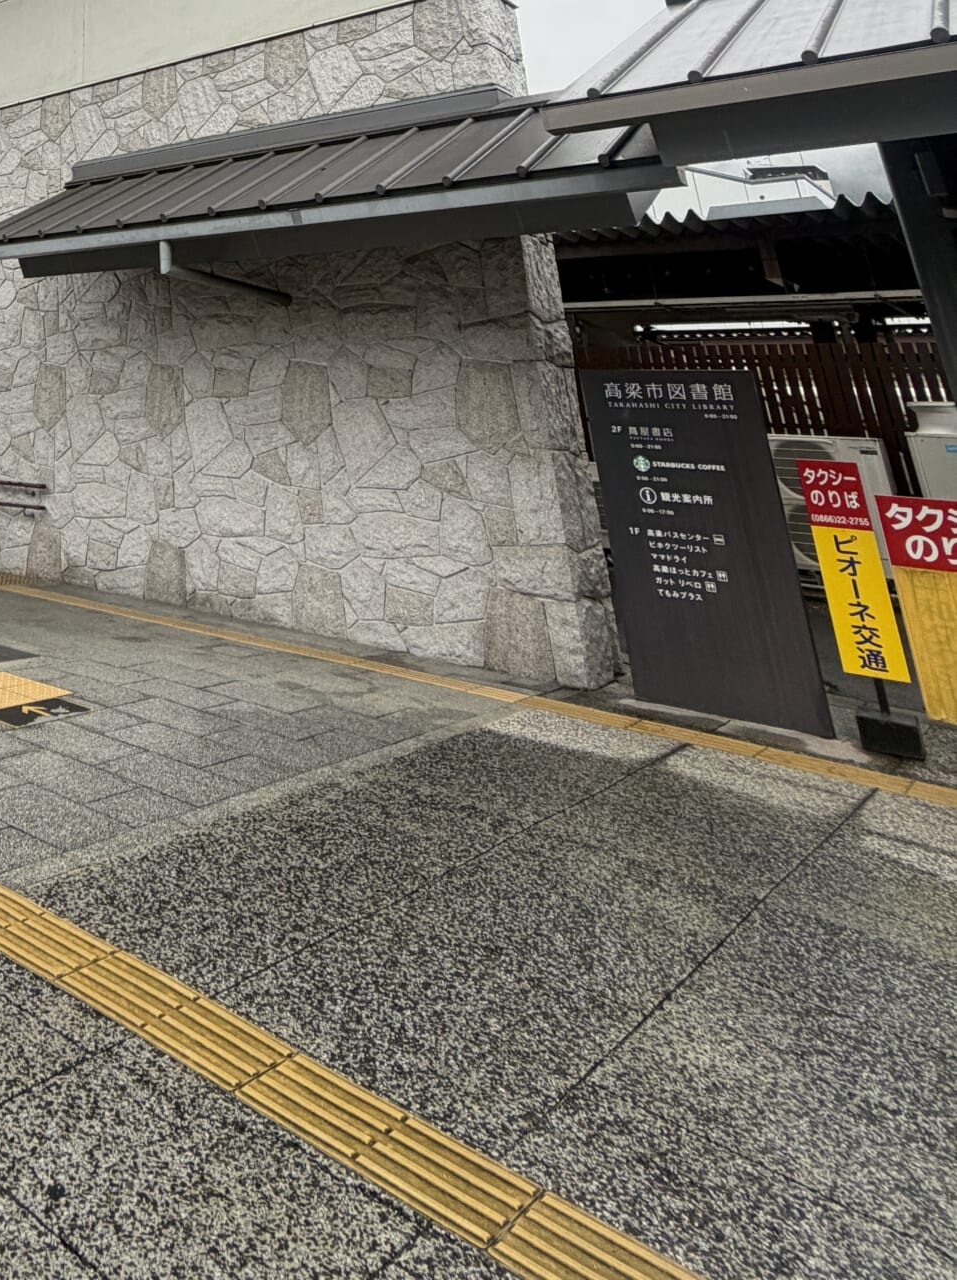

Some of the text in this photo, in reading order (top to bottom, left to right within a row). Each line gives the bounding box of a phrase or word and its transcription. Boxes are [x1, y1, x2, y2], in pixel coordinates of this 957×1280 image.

[603, 382, 734, 401] 高梁市図書館
[608, 401, 660, 409] TAKAHASHI
[611, 425, 622, 433] 2F
[652, 461, 726, 472] STARBUCKS COFFEE
[803, 468, 857, 485] タクシー
[660, 492, 713, 505] 観光案内所
[810, 490, 860, 509] のりば
[628, 527, 641, 535] 1F
[833, 535, 889, 672] ピオーネ交通
